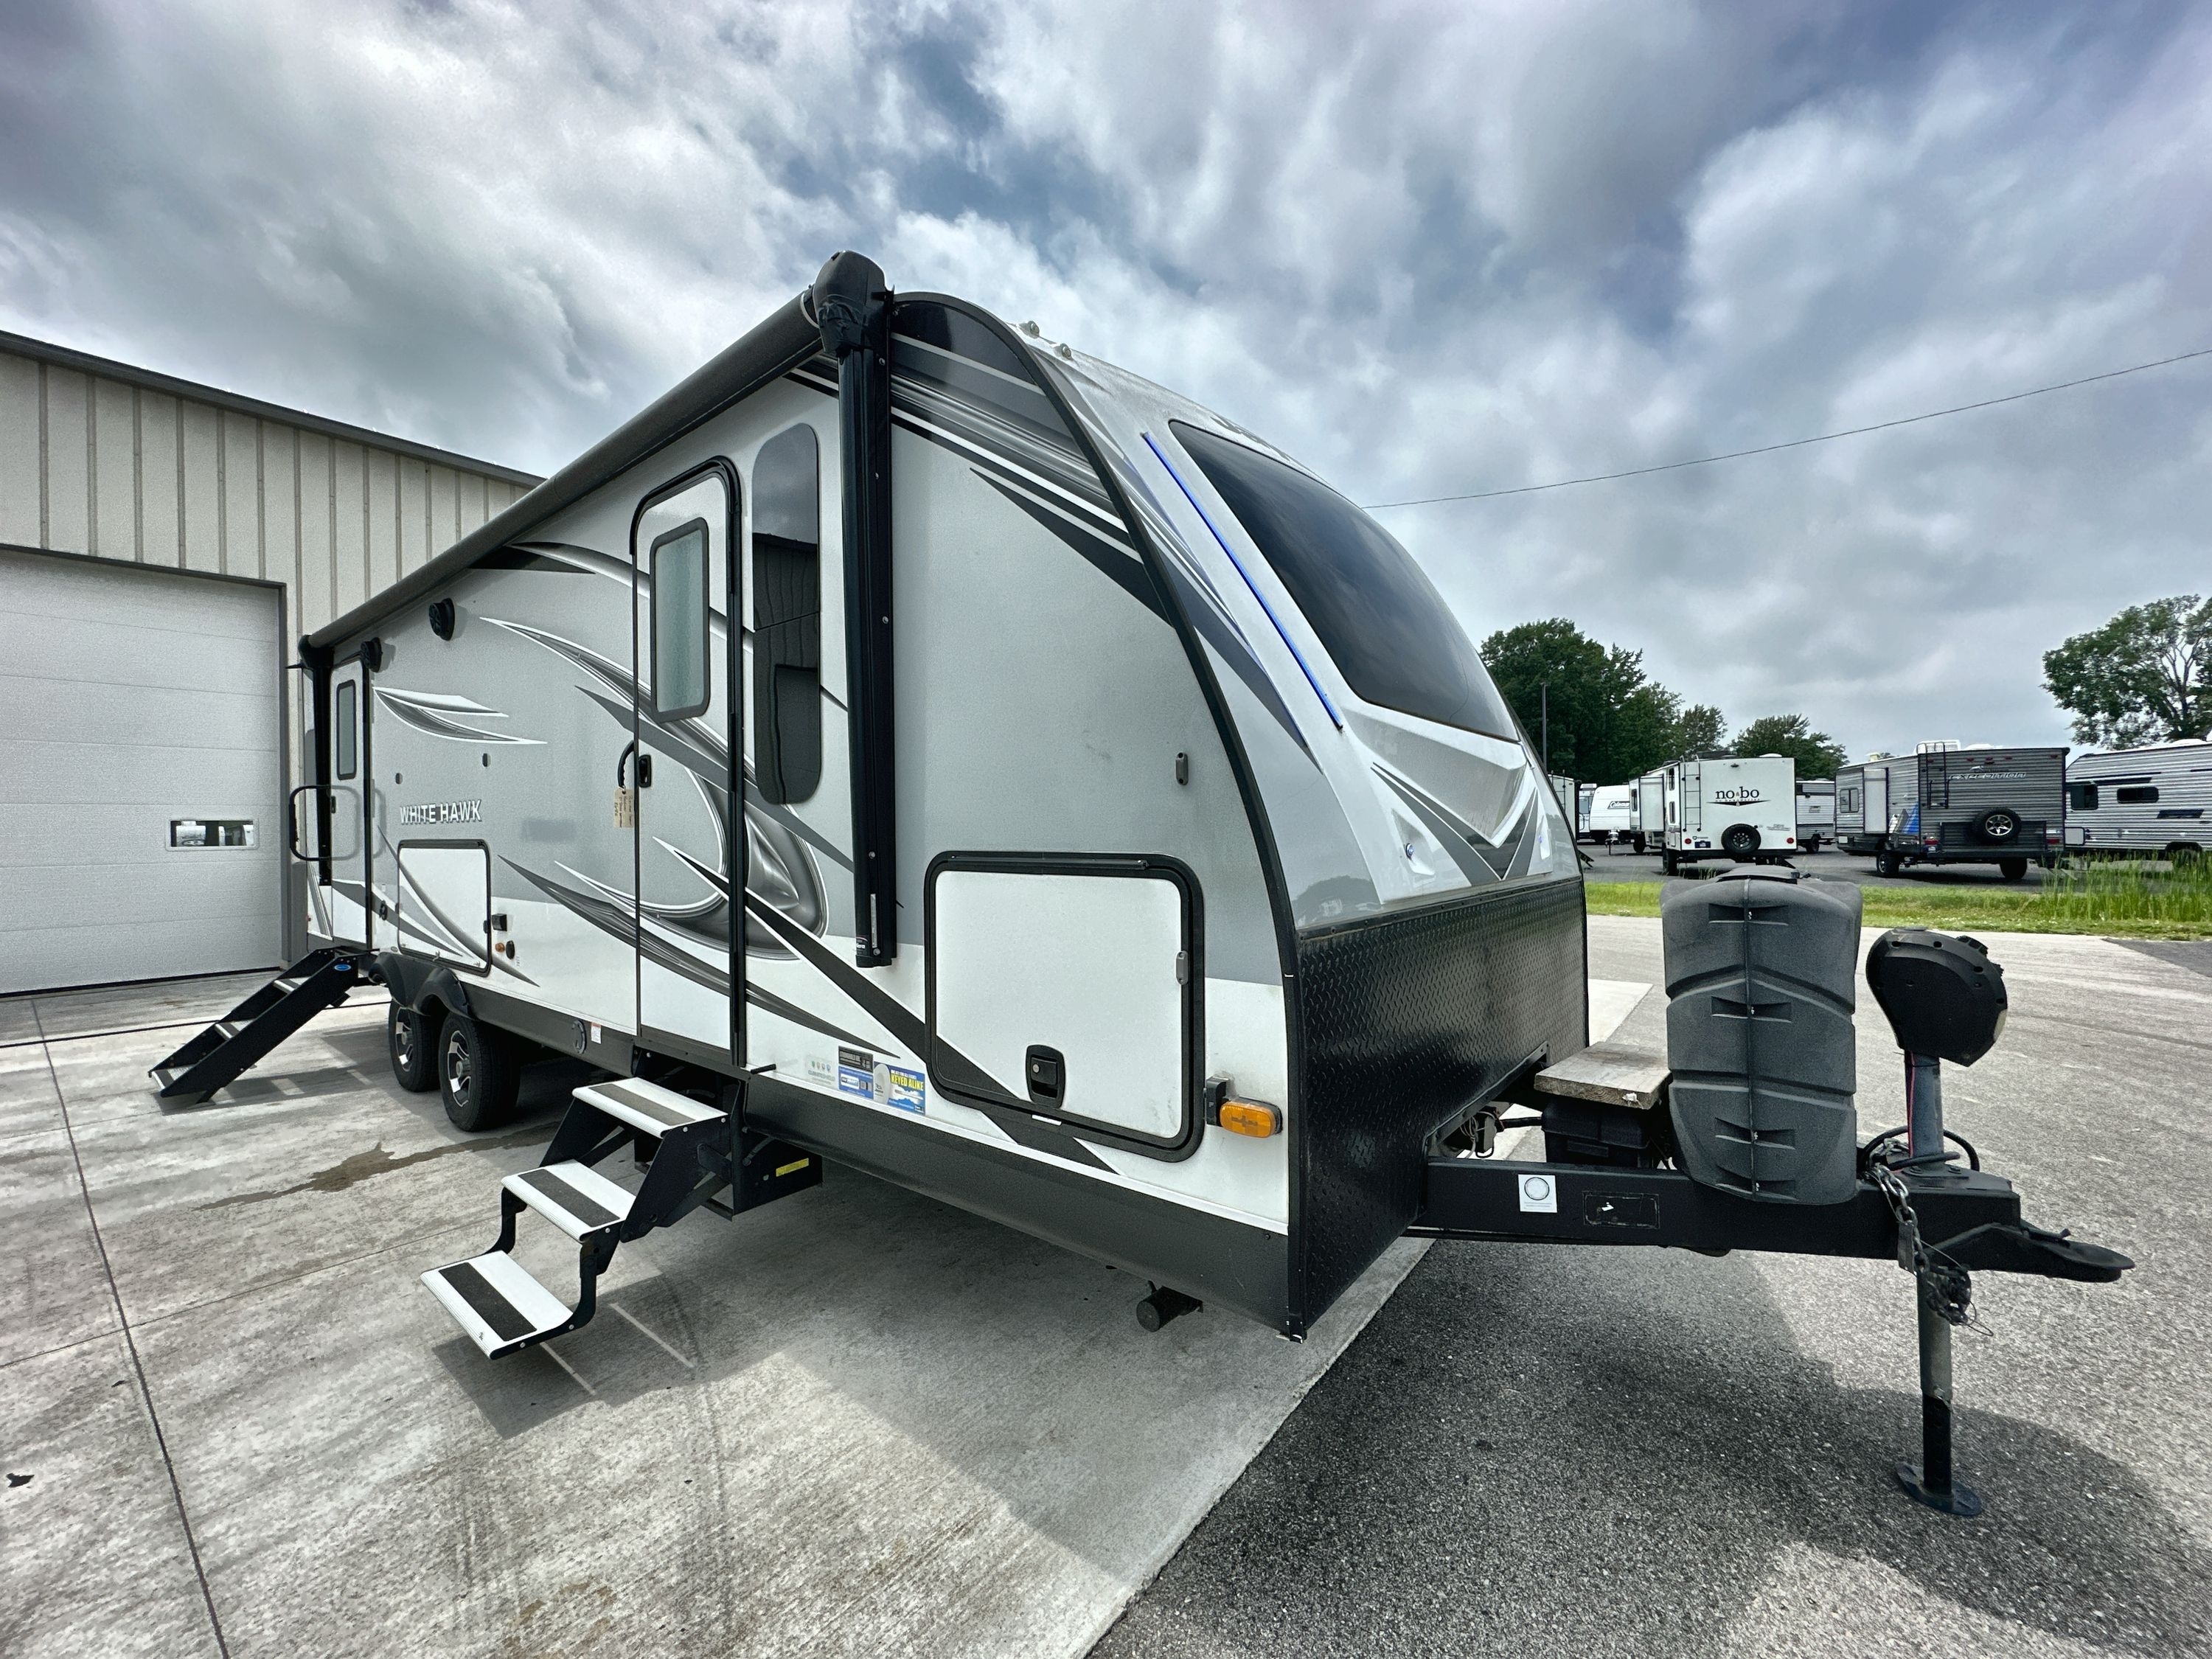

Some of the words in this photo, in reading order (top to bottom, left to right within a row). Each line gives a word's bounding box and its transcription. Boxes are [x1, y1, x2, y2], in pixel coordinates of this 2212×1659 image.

[400, 804, 437, 824] WHITE
[439, 799, 482, 824] HAWK
[891, 1074, 908, 1086] KEYED
[908, 1078, 925, 1091] ALIKE
